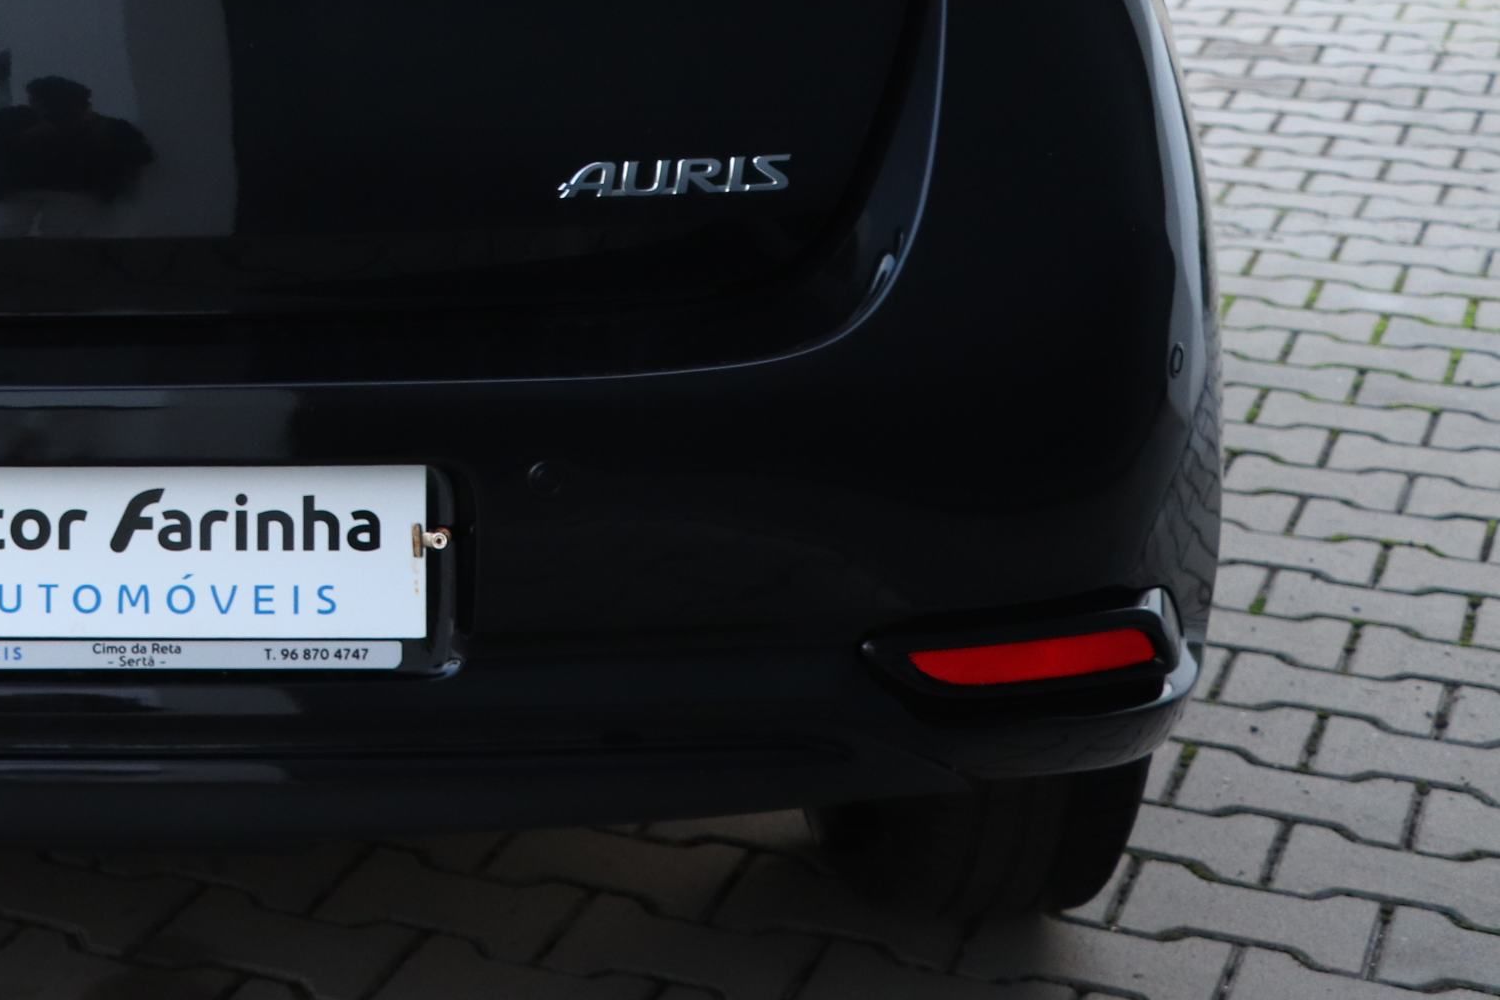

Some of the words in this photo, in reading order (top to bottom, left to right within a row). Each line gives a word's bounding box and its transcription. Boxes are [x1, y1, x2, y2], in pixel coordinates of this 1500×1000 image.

[557, 153, 791, 199] AURIS
[109, 487, 382, 554] Farinha
[92, 642, 127, 655] Cimo
[131, 642, 147, 655] da
[151, 642, 182, 655] Reta
[264, 648, 276, 661] T.
[280, 648, 299, 661] 96
[303, 648, 330, 661] 870
[334, 648, 369, 661] 4747
